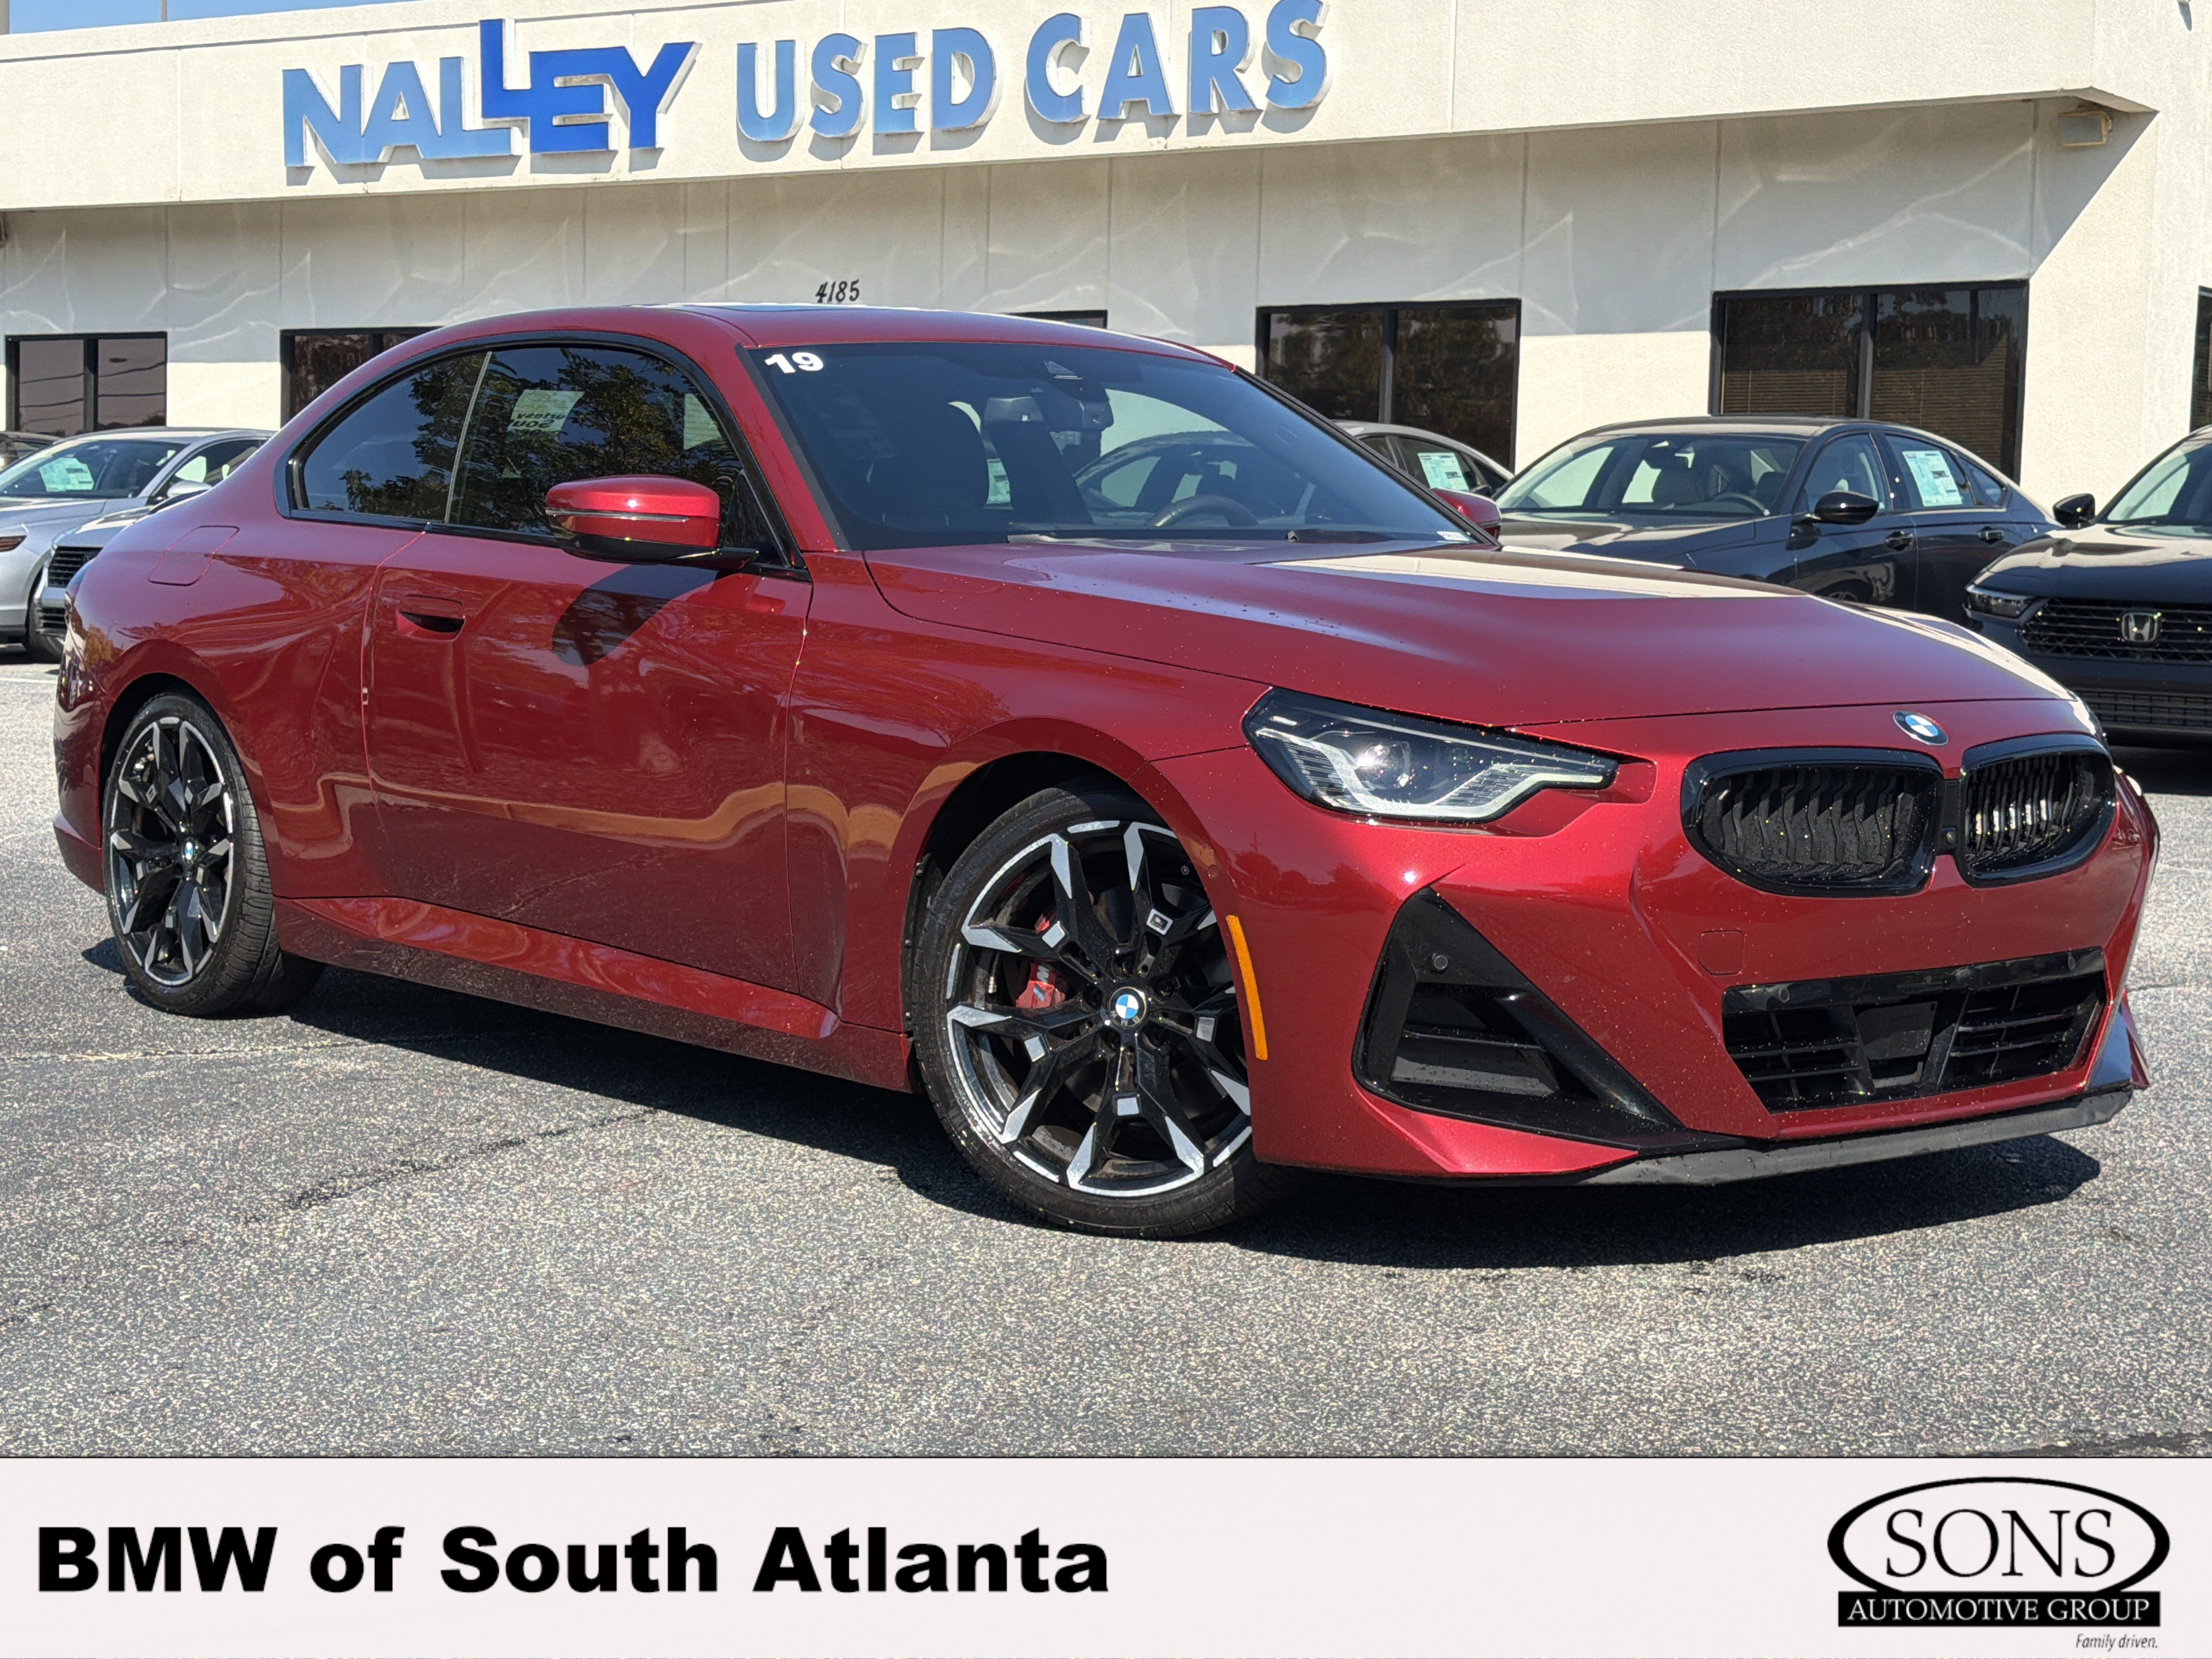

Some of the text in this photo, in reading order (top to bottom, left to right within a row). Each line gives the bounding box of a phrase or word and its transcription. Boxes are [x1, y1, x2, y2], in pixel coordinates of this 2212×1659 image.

[283, 0, 1329, 167] NALLEY USED CARS
[815, 278, 860, 303] 4185
[764, 352, 824, 374] 19
